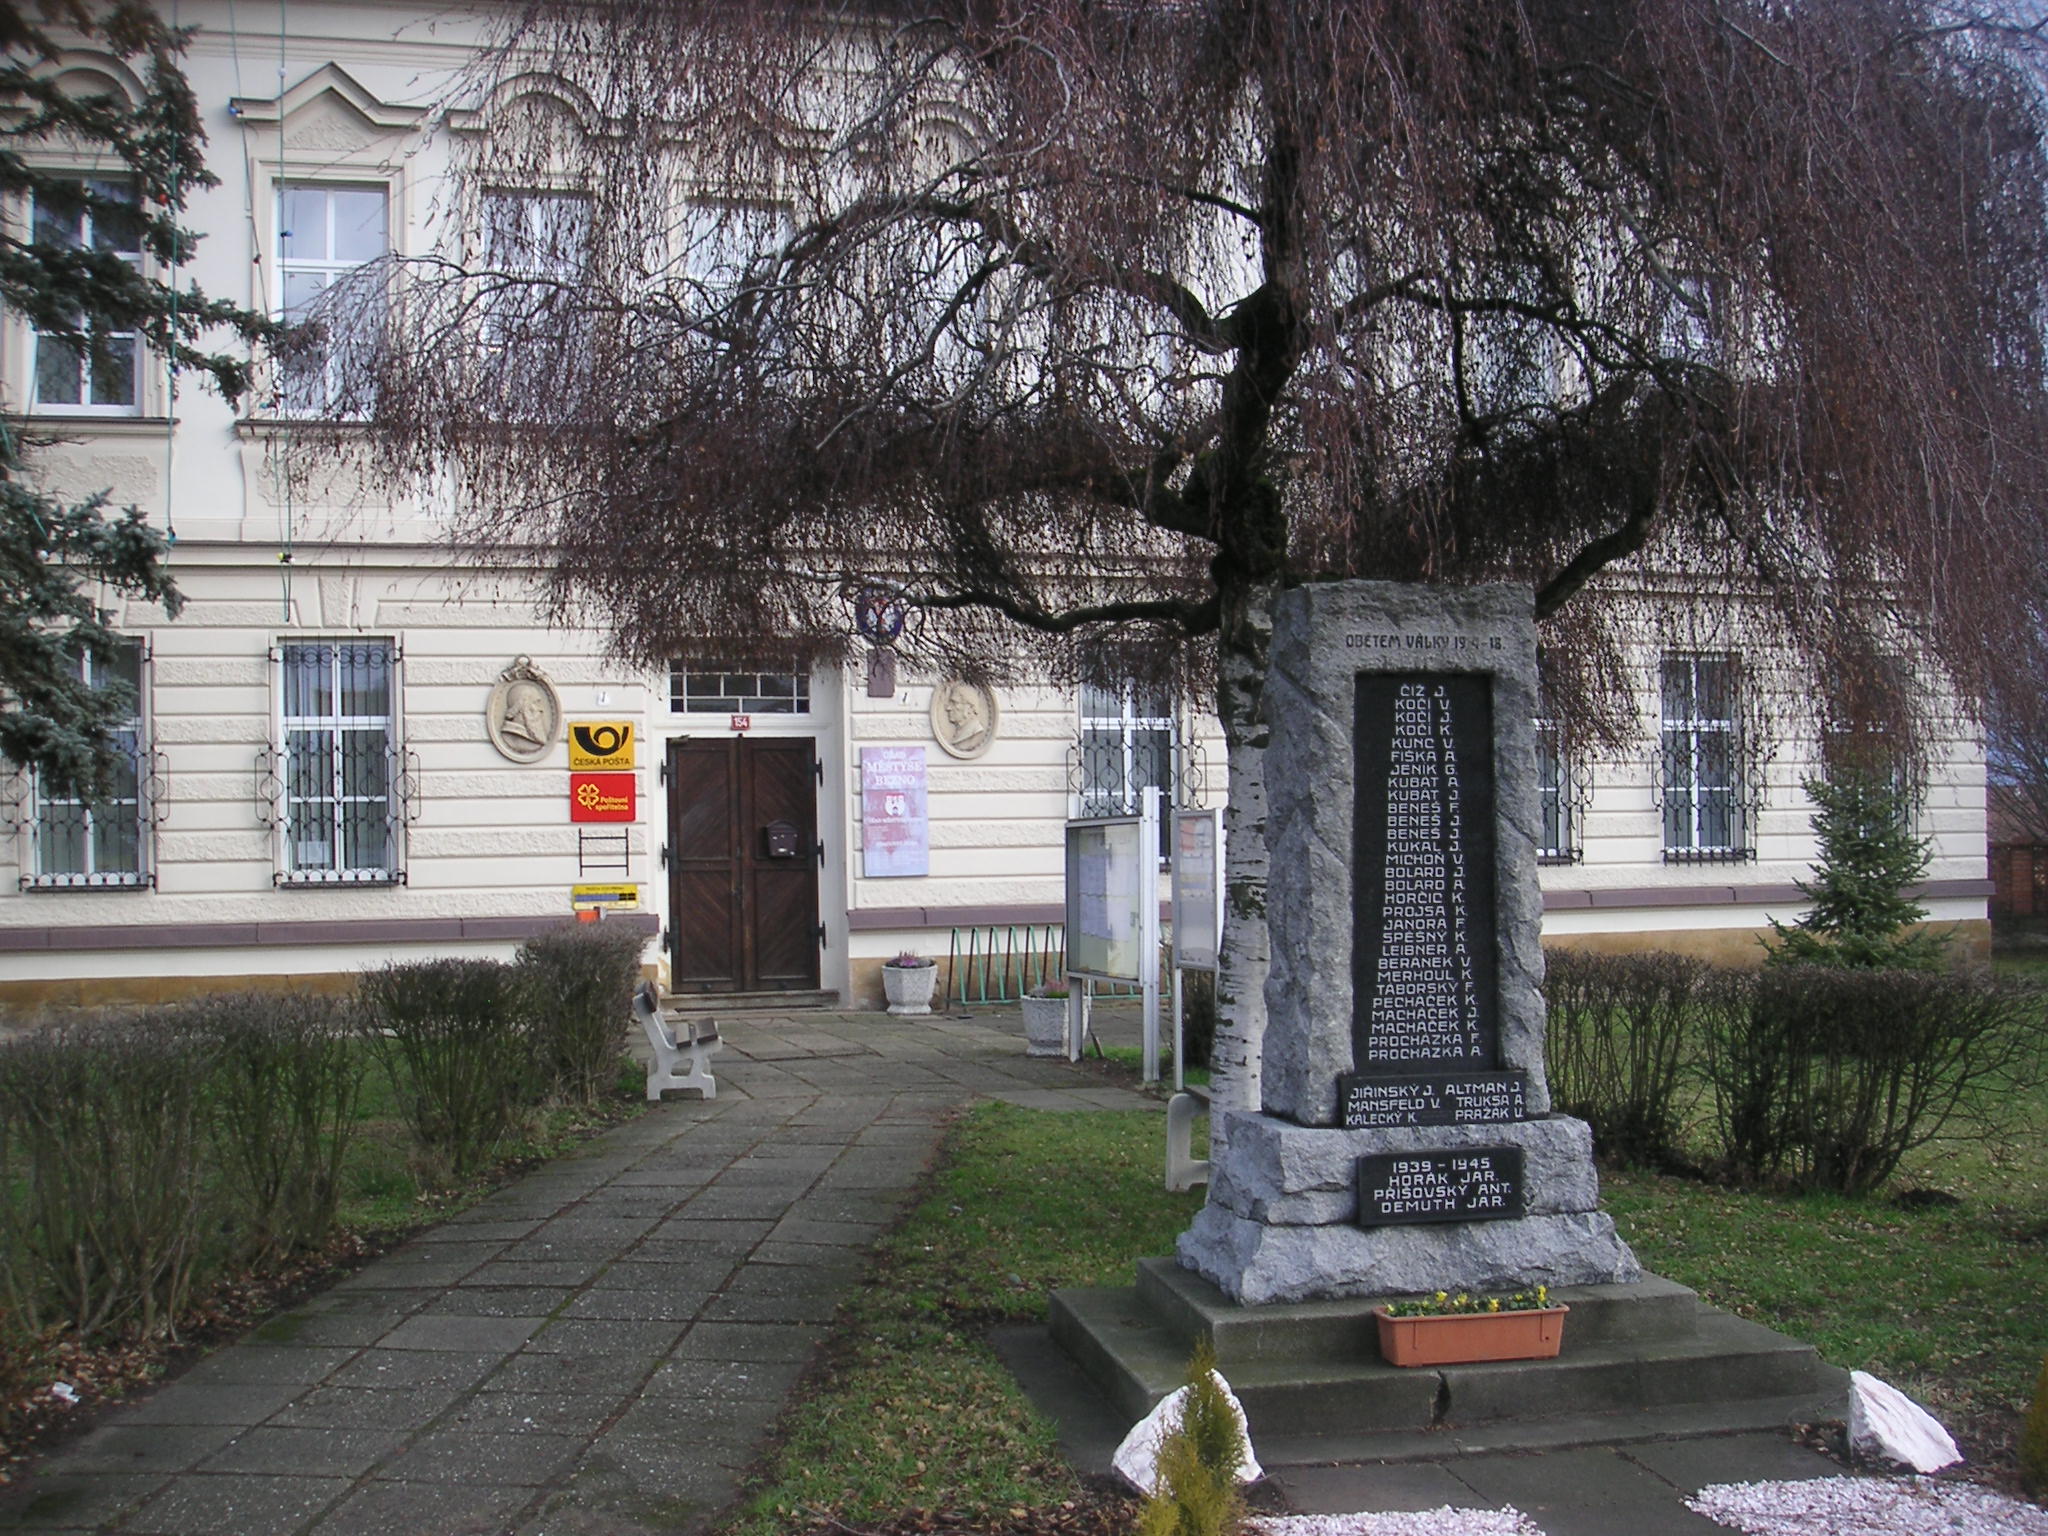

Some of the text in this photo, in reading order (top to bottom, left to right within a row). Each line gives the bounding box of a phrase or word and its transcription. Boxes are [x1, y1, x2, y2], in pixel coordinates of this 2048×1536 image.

[1392, 738, 1434, 748] KUNC
[1387, 841, 1441, 852] KUKAL
[1445, 1083, 1507, 1098] ALTMAN
[1456, 1096, 1509, 1108] TRUKSA
[1393, 1161, 1431, 1173] 1939
[1452, 1158, 1489, 1170] 1945
[1461, 1171, 1499, 1183] JAR.
[1478, 1183, 1511, 1194] ANT.
[1381, 1196, 1506, 1214] DEMUTH JAR.
